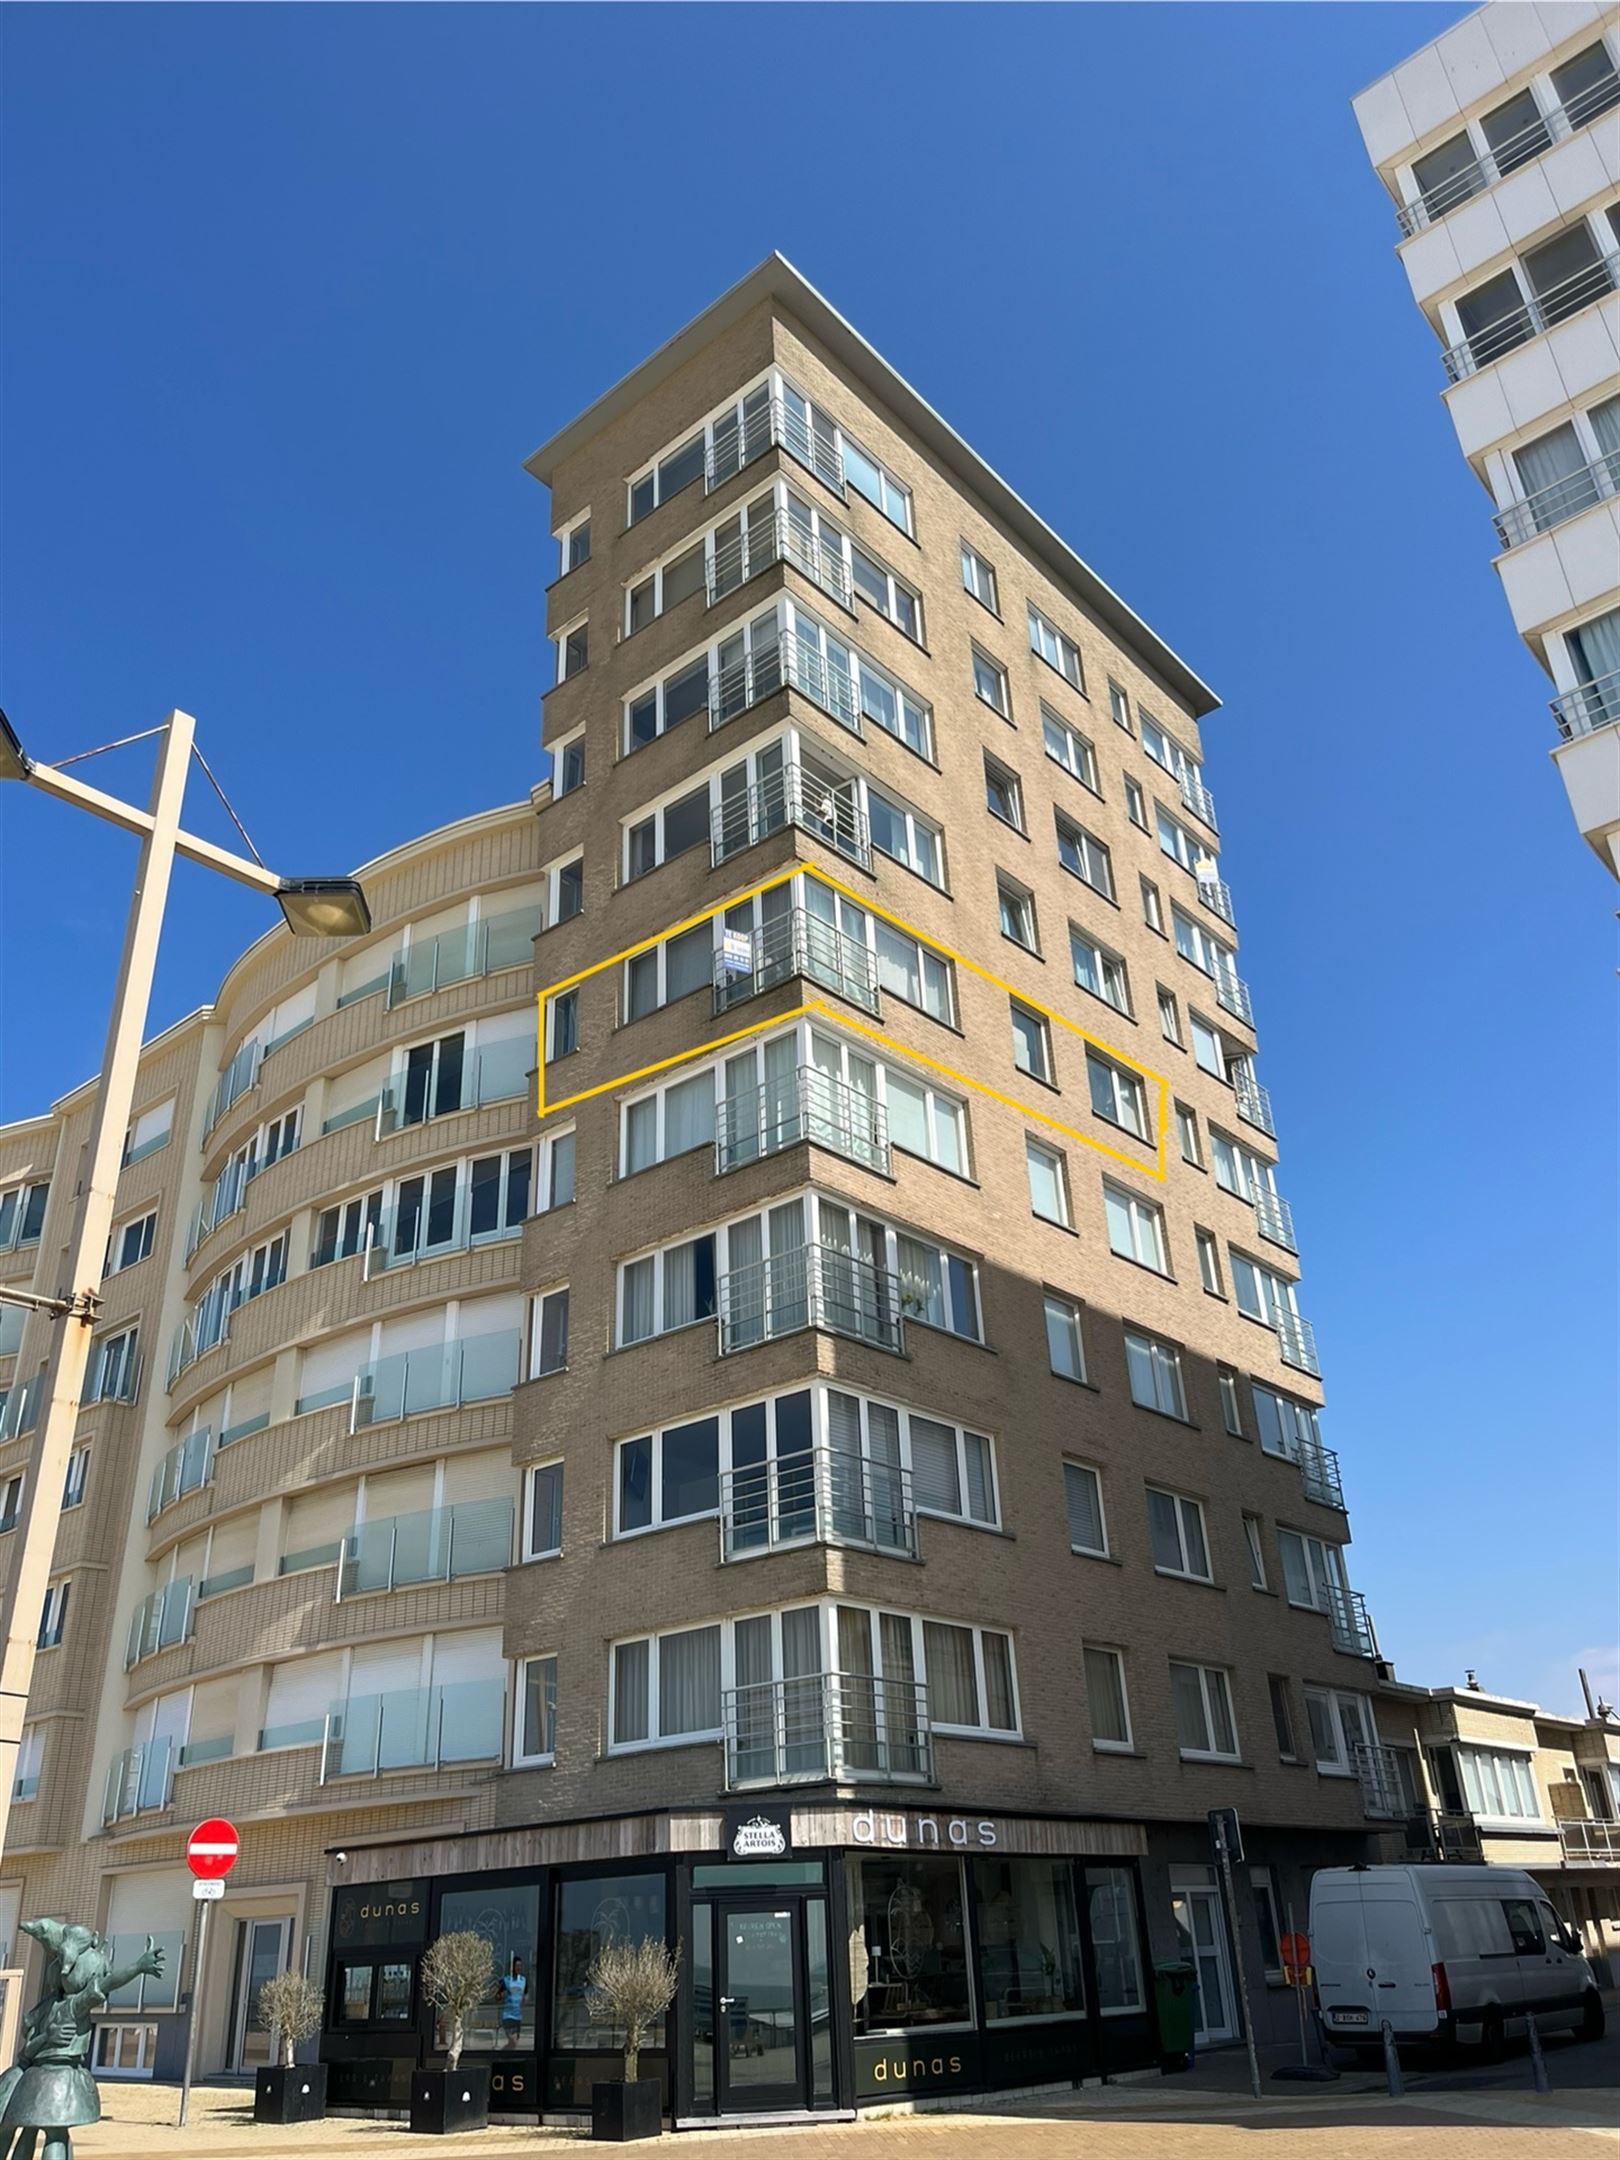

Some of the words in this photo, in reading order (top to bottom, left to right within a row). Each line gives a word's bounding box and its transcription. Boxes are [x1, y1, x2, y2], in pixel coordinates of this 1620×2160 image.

[852, 1809, 997, 1846] dunas
[743, 1840, 776, 1848] ARTOIS
[360, 1901, 420, 1919] dunas
[874, 2056, 962, 2081] dunas
